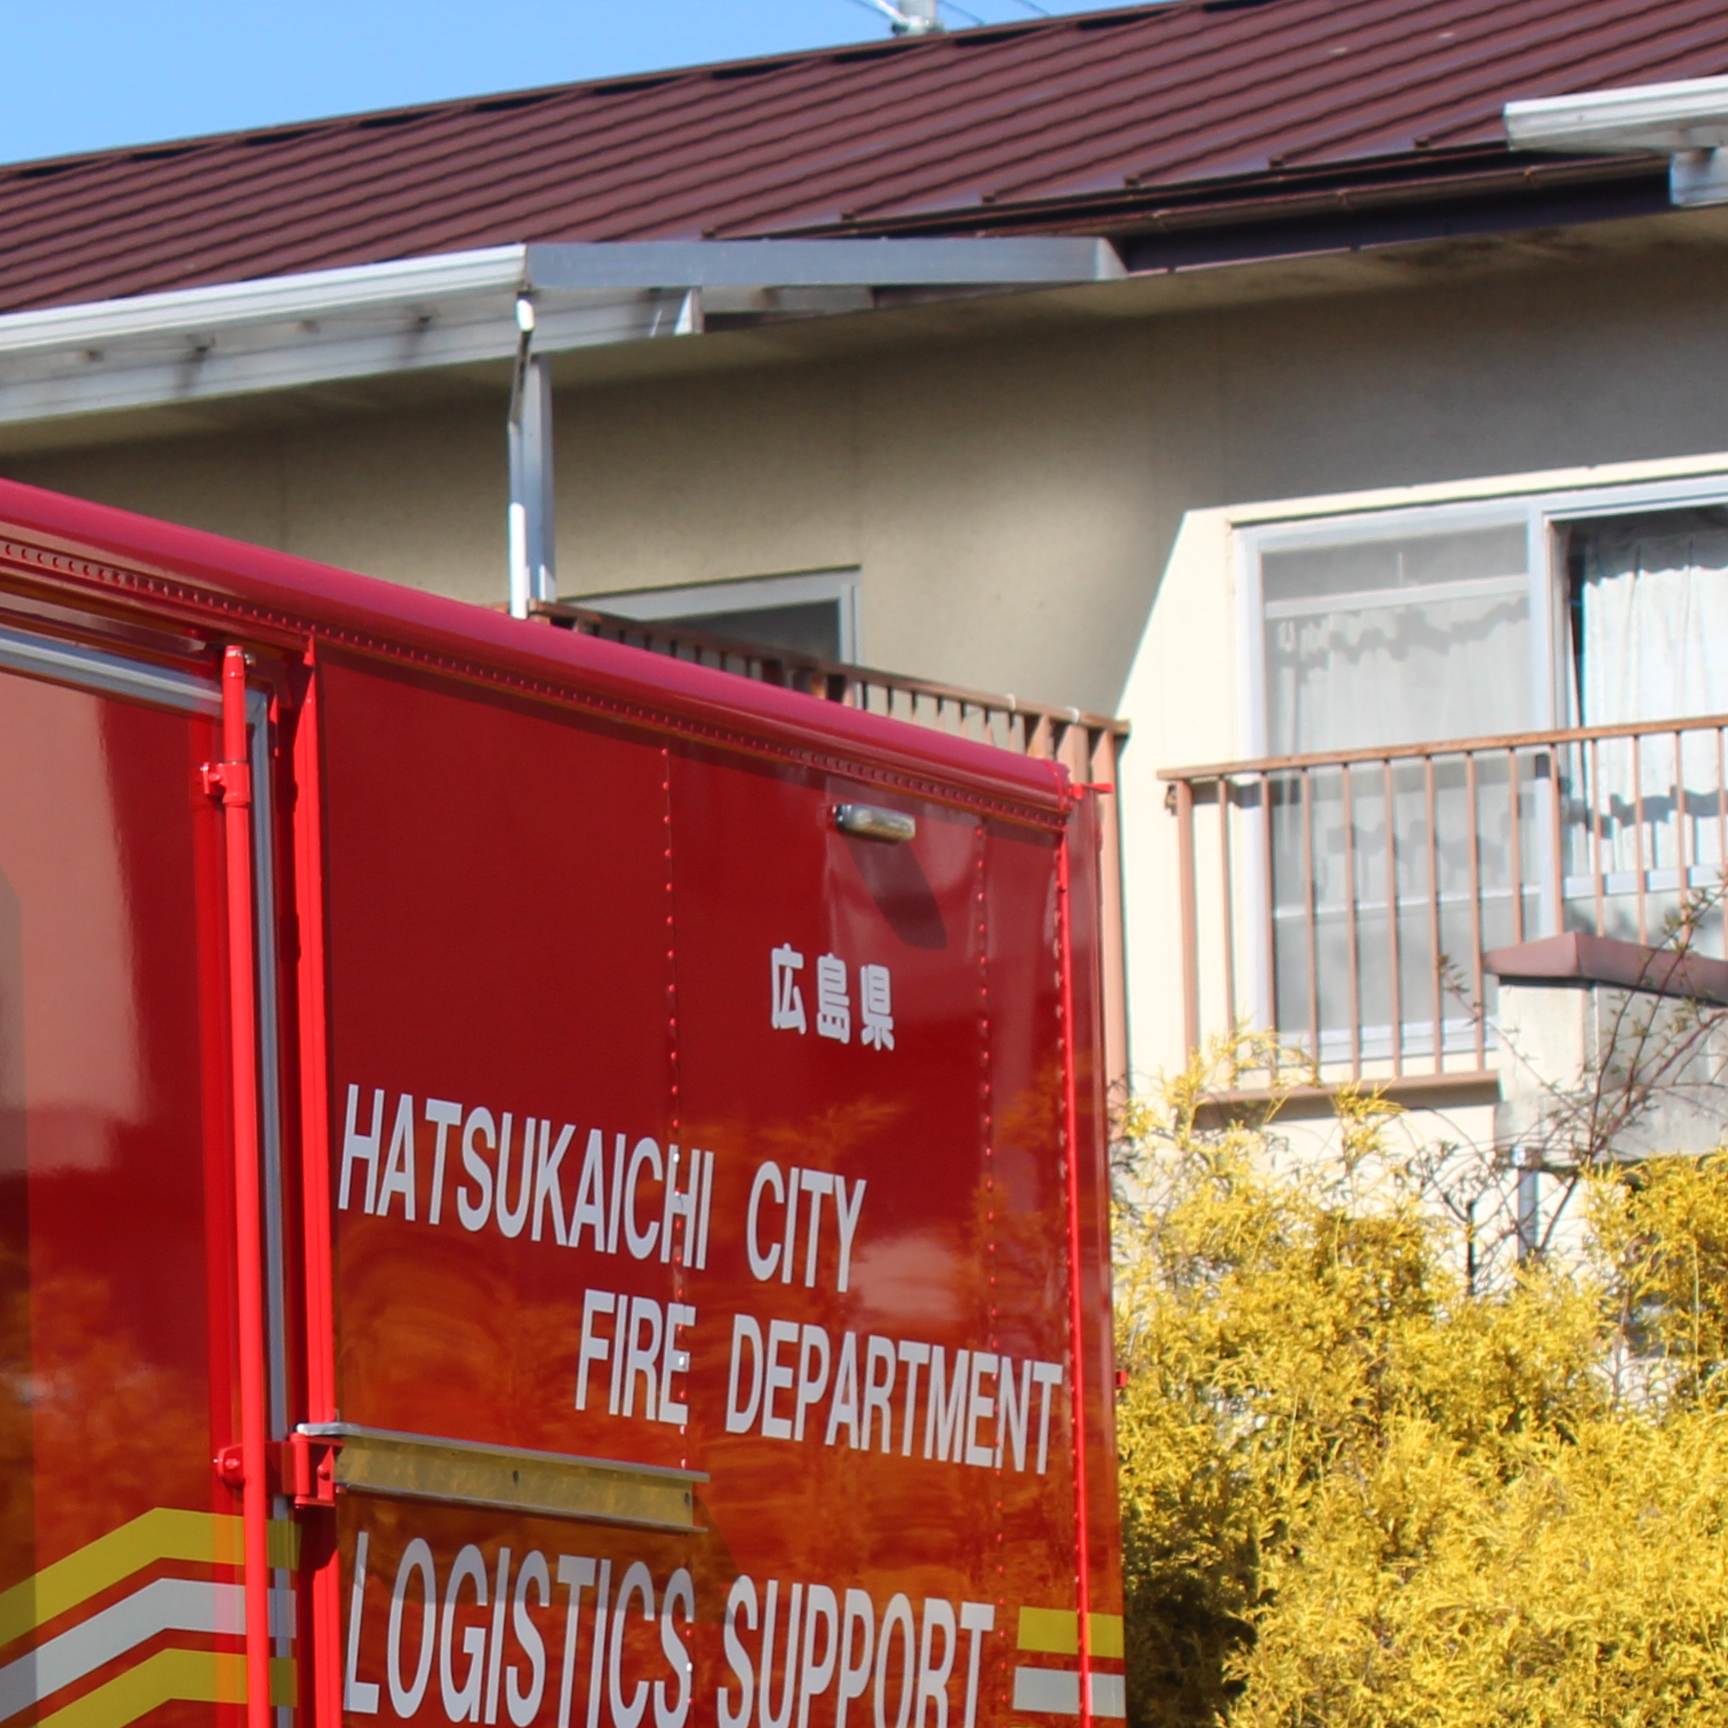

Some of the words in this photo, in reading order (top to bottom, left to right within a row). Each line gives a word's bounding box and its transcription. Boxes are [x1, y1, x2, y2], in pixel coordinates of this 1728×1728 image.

[771, 943, 895, 1051] 広島県
[338, 1084, 714, 1270] HATSUKAICHI
[747, 1161, 867, 1293] CITY
[575, 1289, 696, 1426] FIRE
[725, 1314, 1064, 1475] DEPARTMENT
